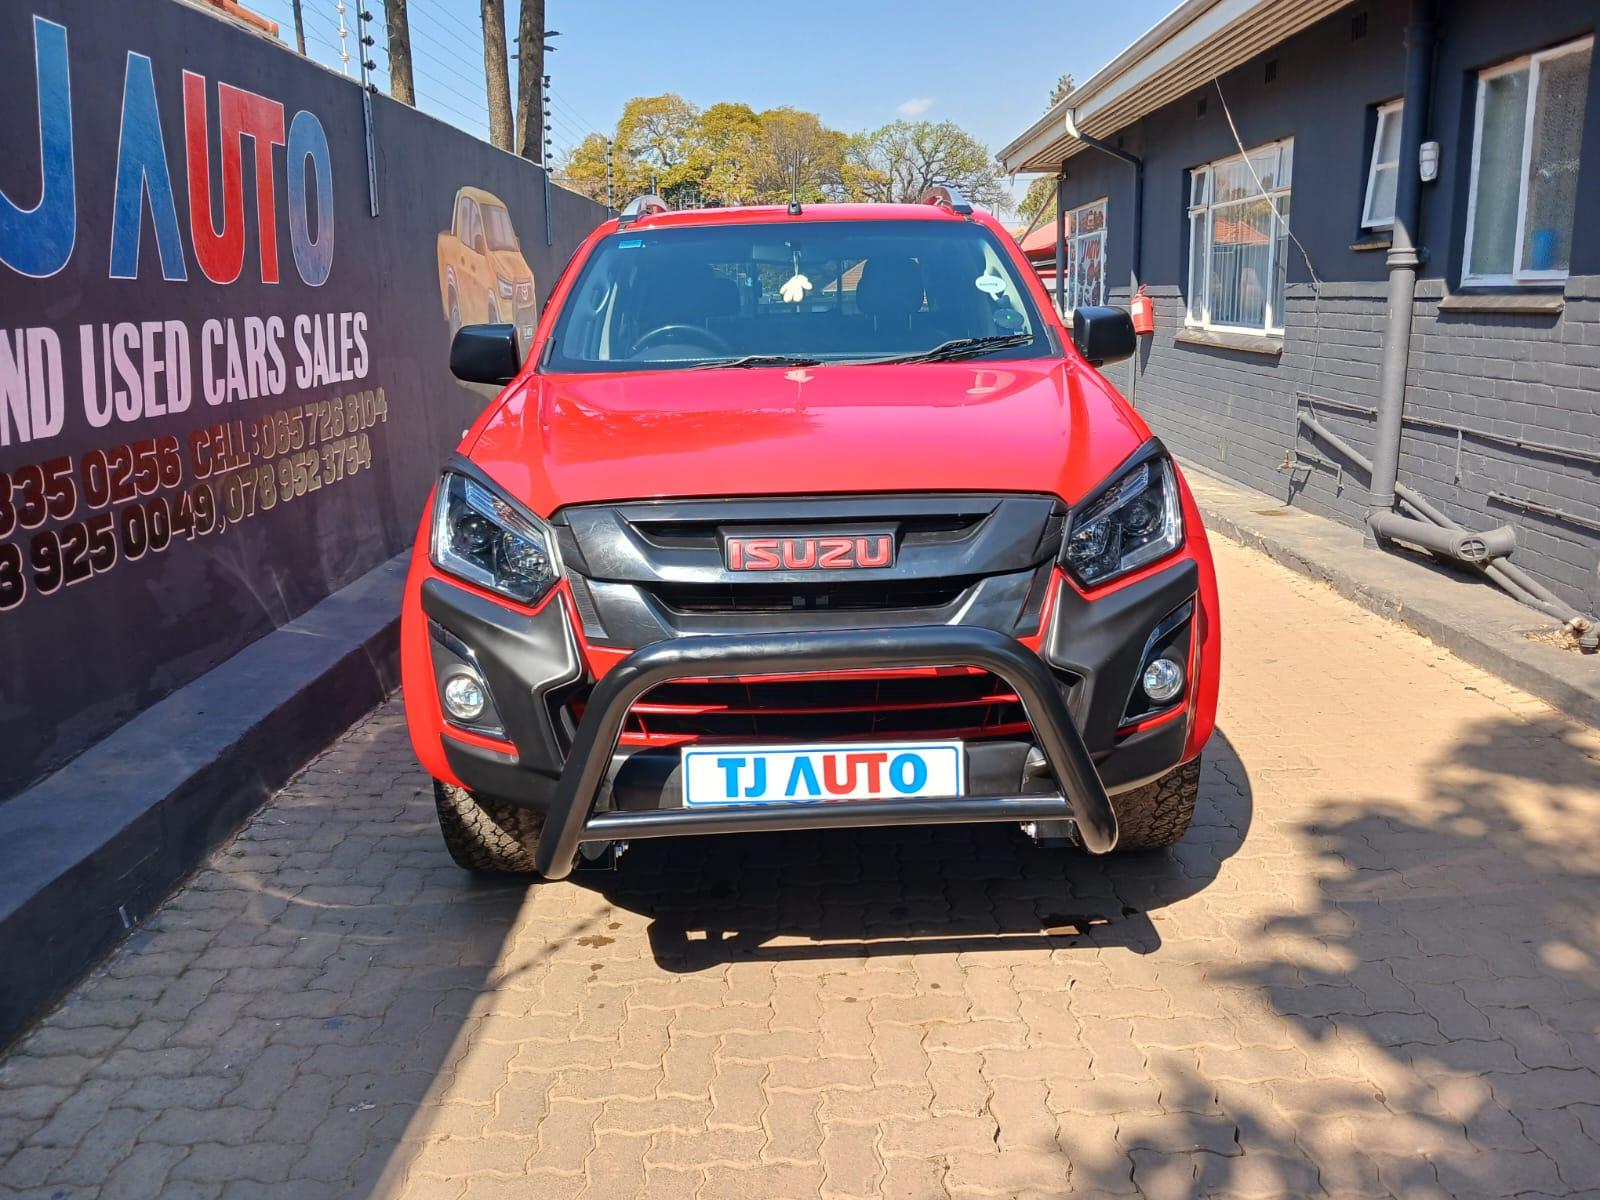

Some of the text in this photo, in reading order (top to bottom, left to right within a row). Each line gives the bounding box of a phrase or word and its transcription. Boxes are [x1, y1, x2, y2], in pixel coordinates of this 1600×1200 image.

[109, 50, 335, 287] AUTO
[0, 311, 369, 446] ND USED CARS SALES
[80, 435, 182, 509] 0256
[306, 397, 345, 446] 726
[345, 387, 389, 433] 8104
[30, 511, 118, 595] 925
[277, 448, 322, 502] 952
[321, 432, 372, 485] 3754
[729, 536, 891, 570] ISUZU
[717, 752, 928, 798] TJ AUTO
